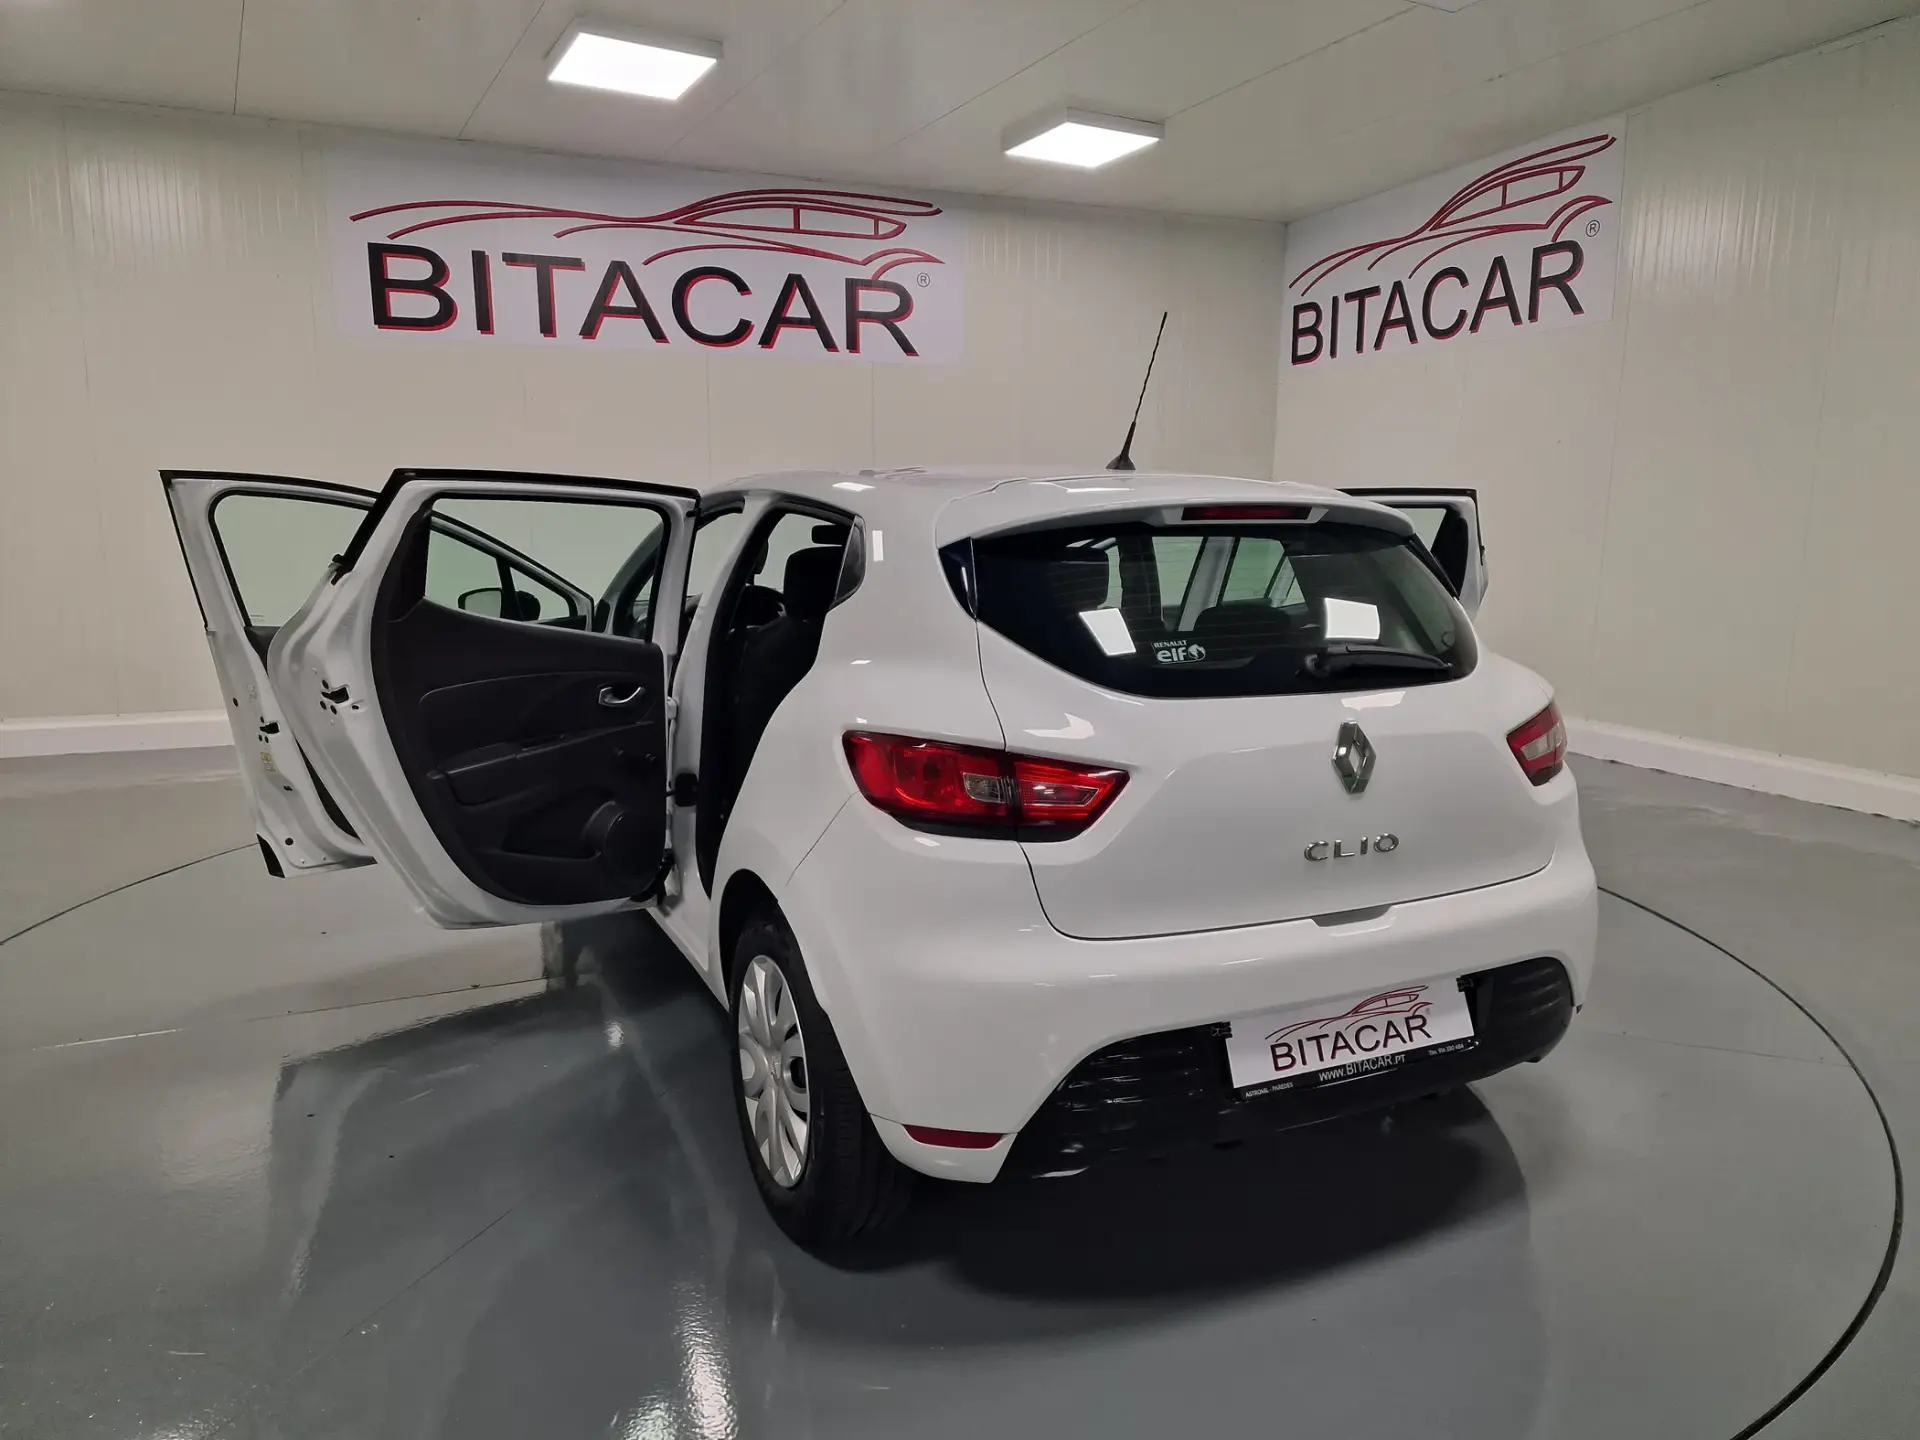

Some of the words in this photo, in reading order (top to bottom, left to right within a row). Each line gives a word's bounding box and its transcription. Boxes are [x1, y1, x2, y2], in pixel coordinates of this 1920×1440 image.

[367, 242, 919, 357] BITACAR
[1292, 240, 1584, 365] BITACAR
[1154, 640, 1187, 648] RENAULT
[1157, 647, 1187, 662] elf
[1304, 833, 1400, 861] CLIO
[1270, 1014, 1432, 1072] BITACAR
